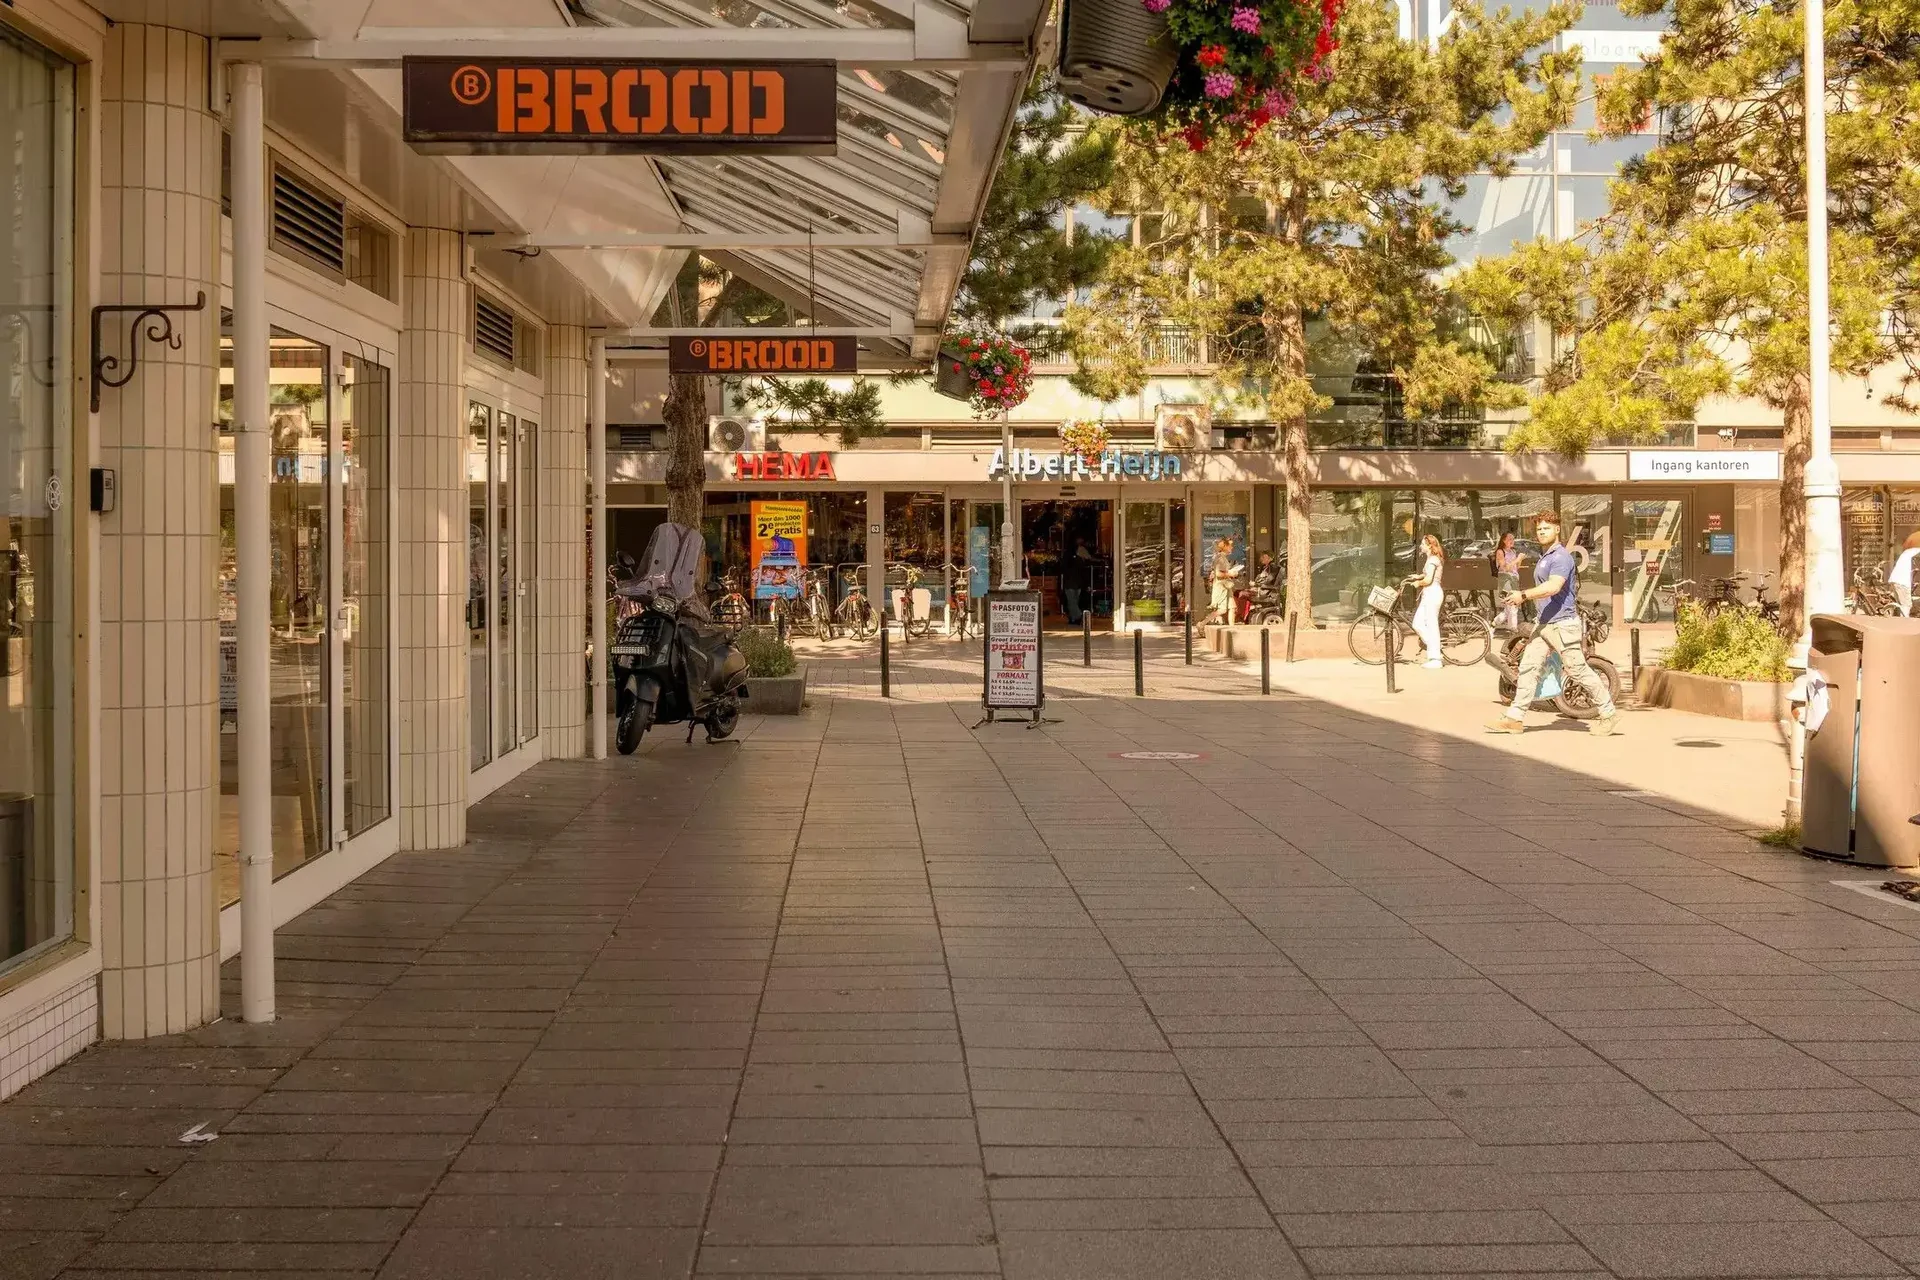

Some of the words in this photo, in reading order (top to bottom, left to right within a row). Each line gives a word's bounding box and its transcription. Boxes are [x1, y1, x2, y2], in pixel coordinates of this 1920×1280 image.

[497, 68, 785, 135] BROOD
[709, 340, 835, 369] BROOD
[736, 452, 837, 481] HEMA
[988, 447, 1089, 476] Albert
[1101, 449, 1181, 480] Heijn
[1651, 459, 1692, 473] Ingang
[1696, 459, 1750, 470] kantoren
[1851, 501, 1884, 511] ALBER
[774, 527, 802, 537] gratis
[1565, 525, 1611, 574] 61
[991, 643, 1036, 652] printen
